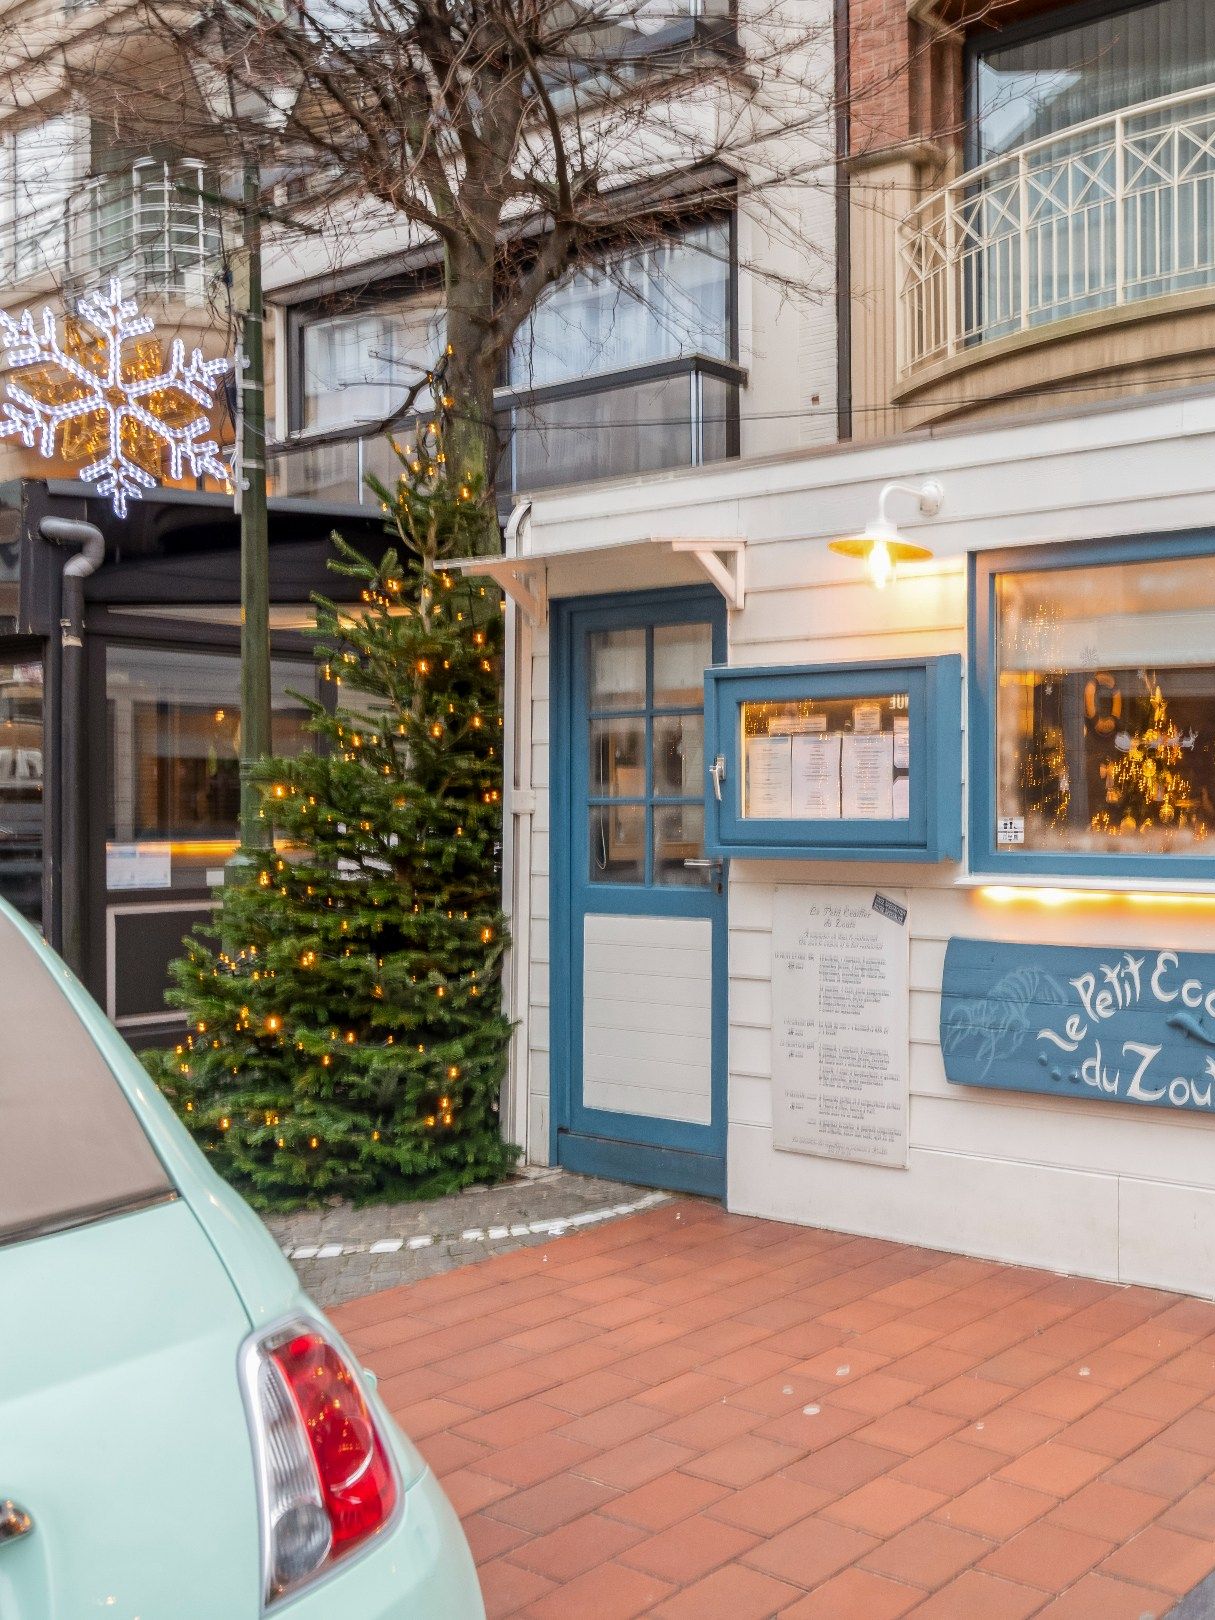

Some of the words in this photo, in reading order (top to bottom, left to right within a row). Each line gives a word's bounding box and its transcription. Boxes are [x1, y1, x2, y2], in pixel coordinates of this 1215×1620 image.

[1037, 1013, 1088, 1052] Le
[1068, 951, 1145, 1024] Petit
[1081, 1039, 1120, 1095] du
